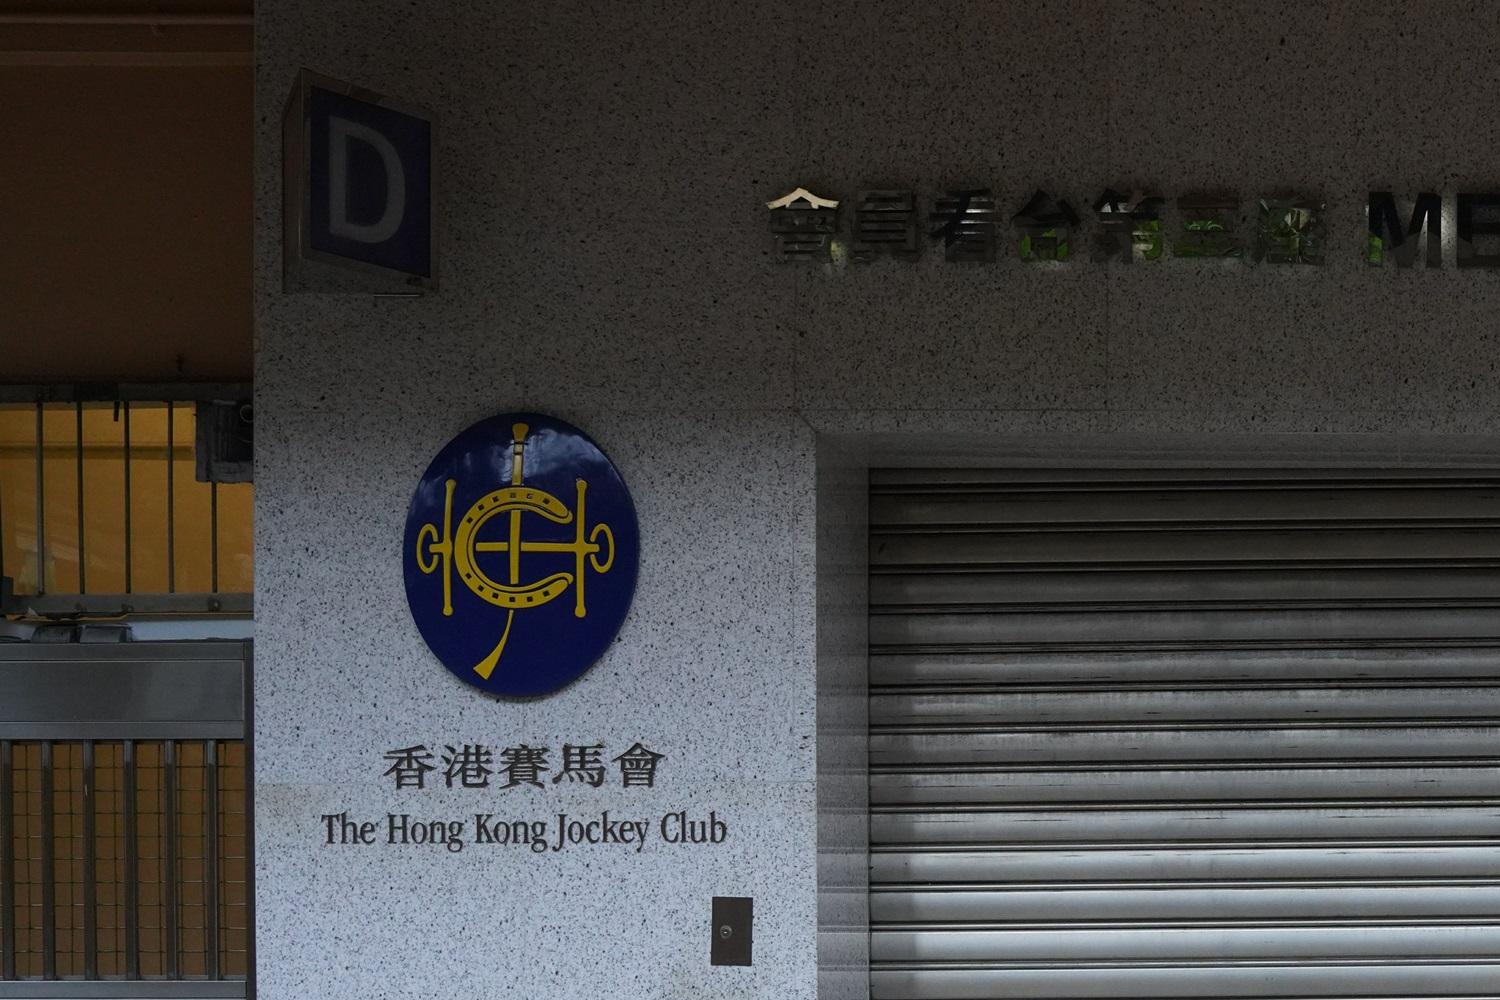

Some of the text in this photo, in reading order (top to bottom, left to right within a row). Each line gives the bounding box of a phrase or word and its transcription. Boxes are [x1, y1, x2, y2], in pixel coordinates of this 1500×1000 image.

[328, 114, 406, 244] D
[382, 742, 666, 790] 香港賽馬會
[321, 811, 728, 853] The Hong Kong Jockey Club
